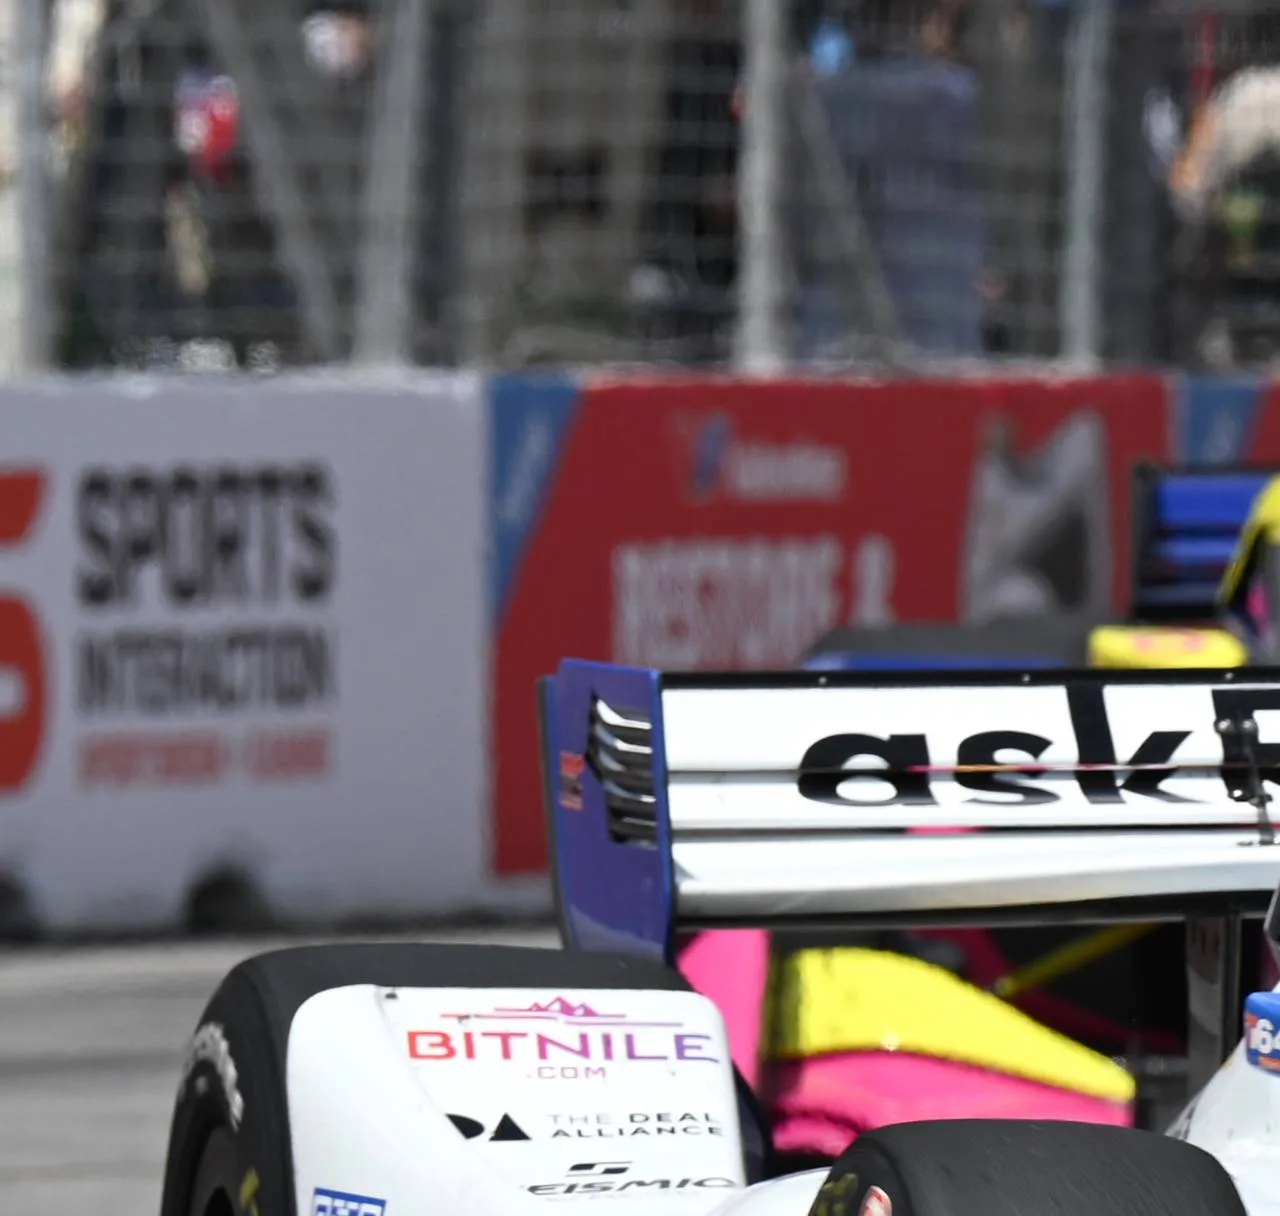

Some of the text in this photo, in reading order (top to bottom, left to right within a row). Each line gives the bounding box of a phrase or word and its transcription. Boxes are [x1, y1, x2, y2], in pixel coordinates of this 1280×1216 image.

[78, 462, 336, 606] SPORTS
[407, 1031, 719, 1064] BITNILE
[548, 1112, 724, 1125] THE DEAL
[550, 1125, 725, 1138] ALLIANCE
